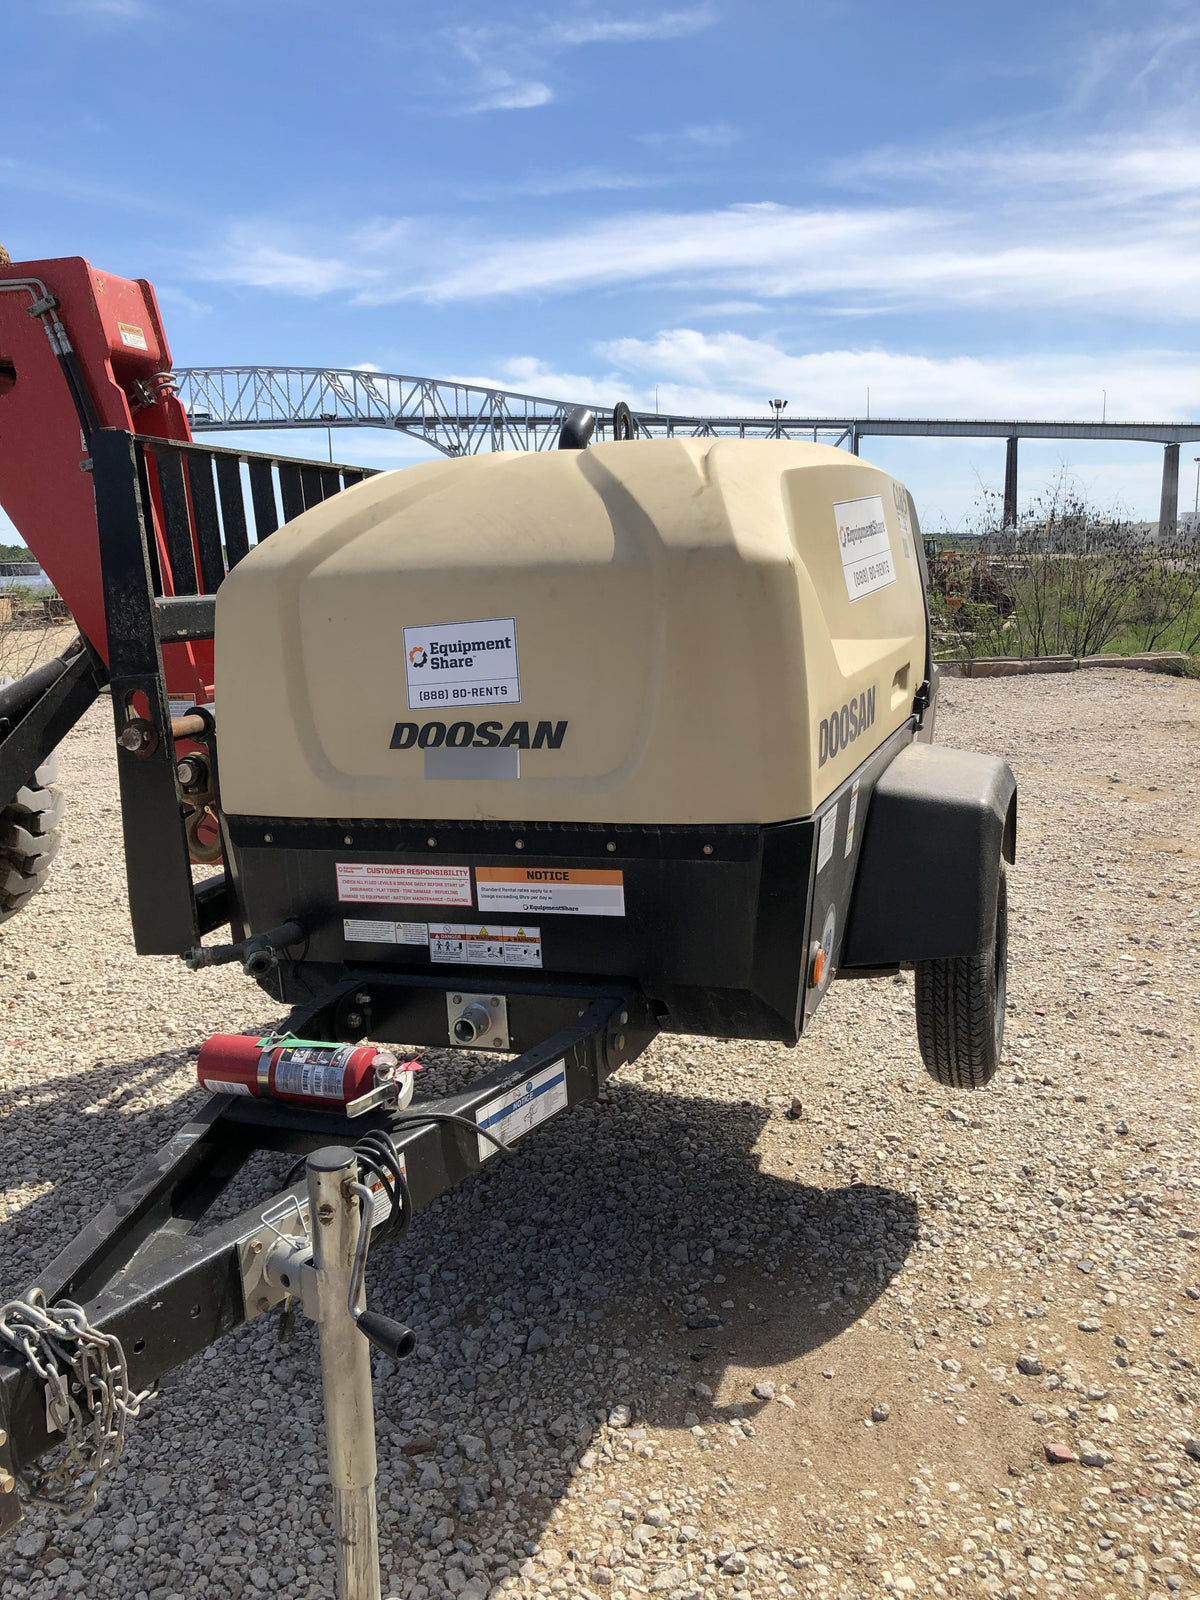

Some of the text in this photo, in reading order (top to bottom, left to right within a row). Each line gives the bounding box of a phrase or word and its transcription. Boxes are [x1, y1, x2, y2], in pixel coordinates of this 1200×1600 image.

[846, 520, 886, 546] EquipmentShare
[853, 560, 890, 588] (888) 80-RENTS
[429, 637, 512, 656] Equipment
[430, 656, 474, 670] Share
[419, 686, 508, 702] (888) 80-RENTS
[389, 721, 569, 750] DOOSAN
[819, 684, 876, 769] DOOSAN
[366, 867, 468, 877] CUSTOMER RESPONSIBILITY
[526, 870, 570, 881] NOTICE
[529, 904, 579, 912] EquipmentShare
[512, 1092, 534, 1111] NOTICE
